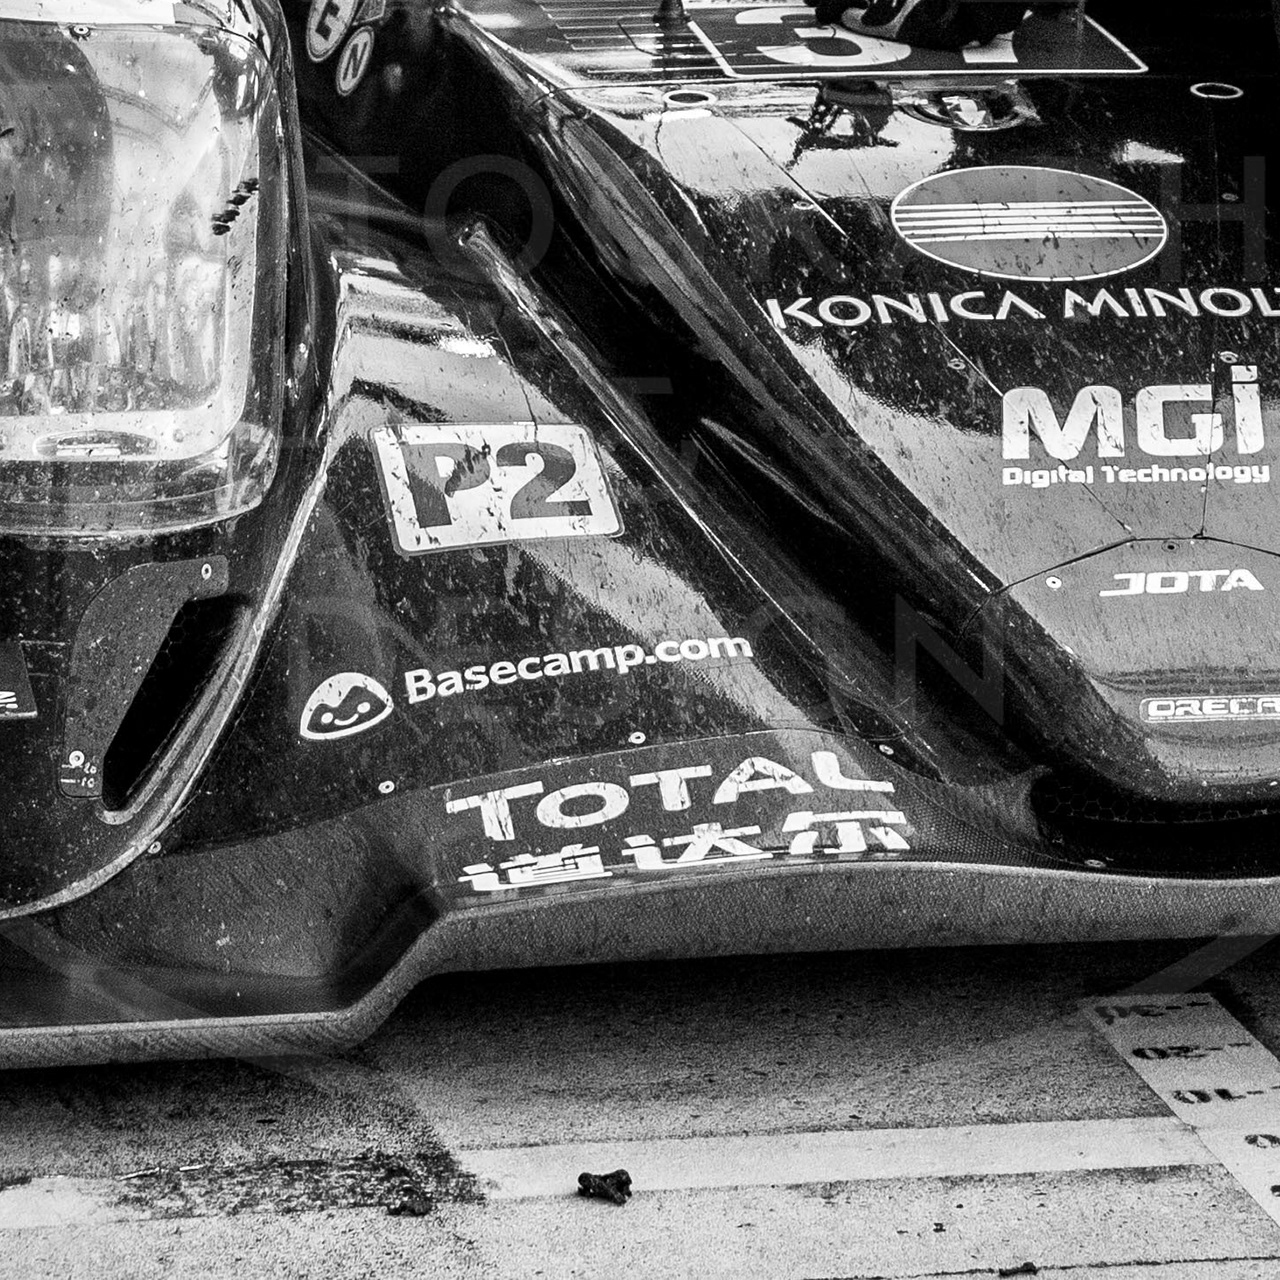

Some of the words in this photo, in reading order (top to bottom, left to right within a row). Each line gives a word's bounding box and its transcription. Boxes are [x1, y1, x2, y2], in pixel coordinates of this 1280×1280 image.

[767, 290, 1046, 329] KONICA
[406, 442, 594, 528] P2
[1002, 465, 1094, 487] Digital
[1101, 461, 1270, 484] Technology
[1099, 568, 1265, 597] JOTA
[404, 635, 754, 705] Basecamp.com
[445, 750, 896, 840] TOTAL
